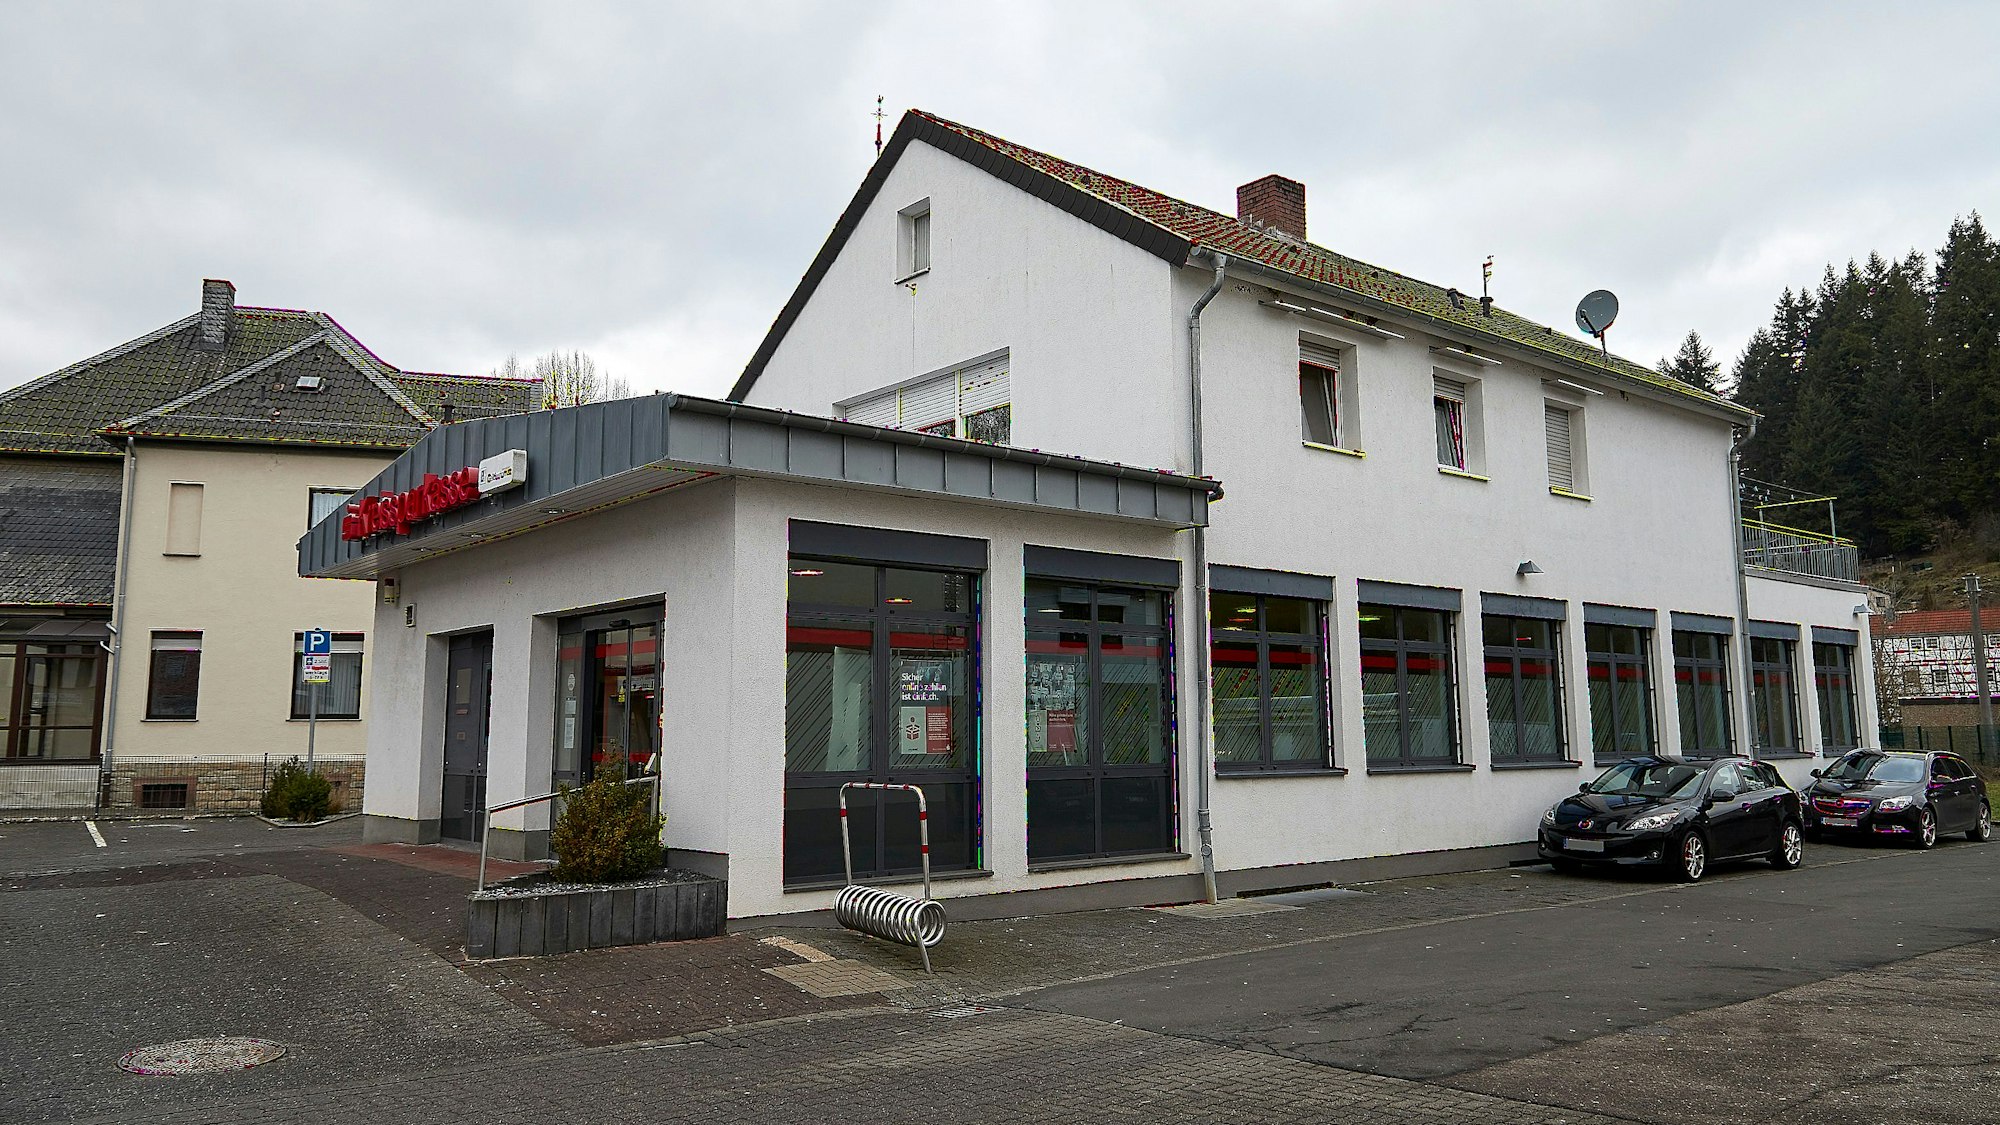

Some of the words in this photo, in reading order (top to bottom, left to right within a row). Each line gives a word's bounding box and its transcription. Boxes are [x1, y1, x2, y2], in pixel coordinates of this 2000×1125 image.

[310, 633, 325, 652] P
[901, 672, 924, 681] Sicher
[901, 682, 923, 691] online
[924, 682, 947, 691] zahlen
[901, 691, 912, 701] ist
[912, 691, 939, 701] einfach.
